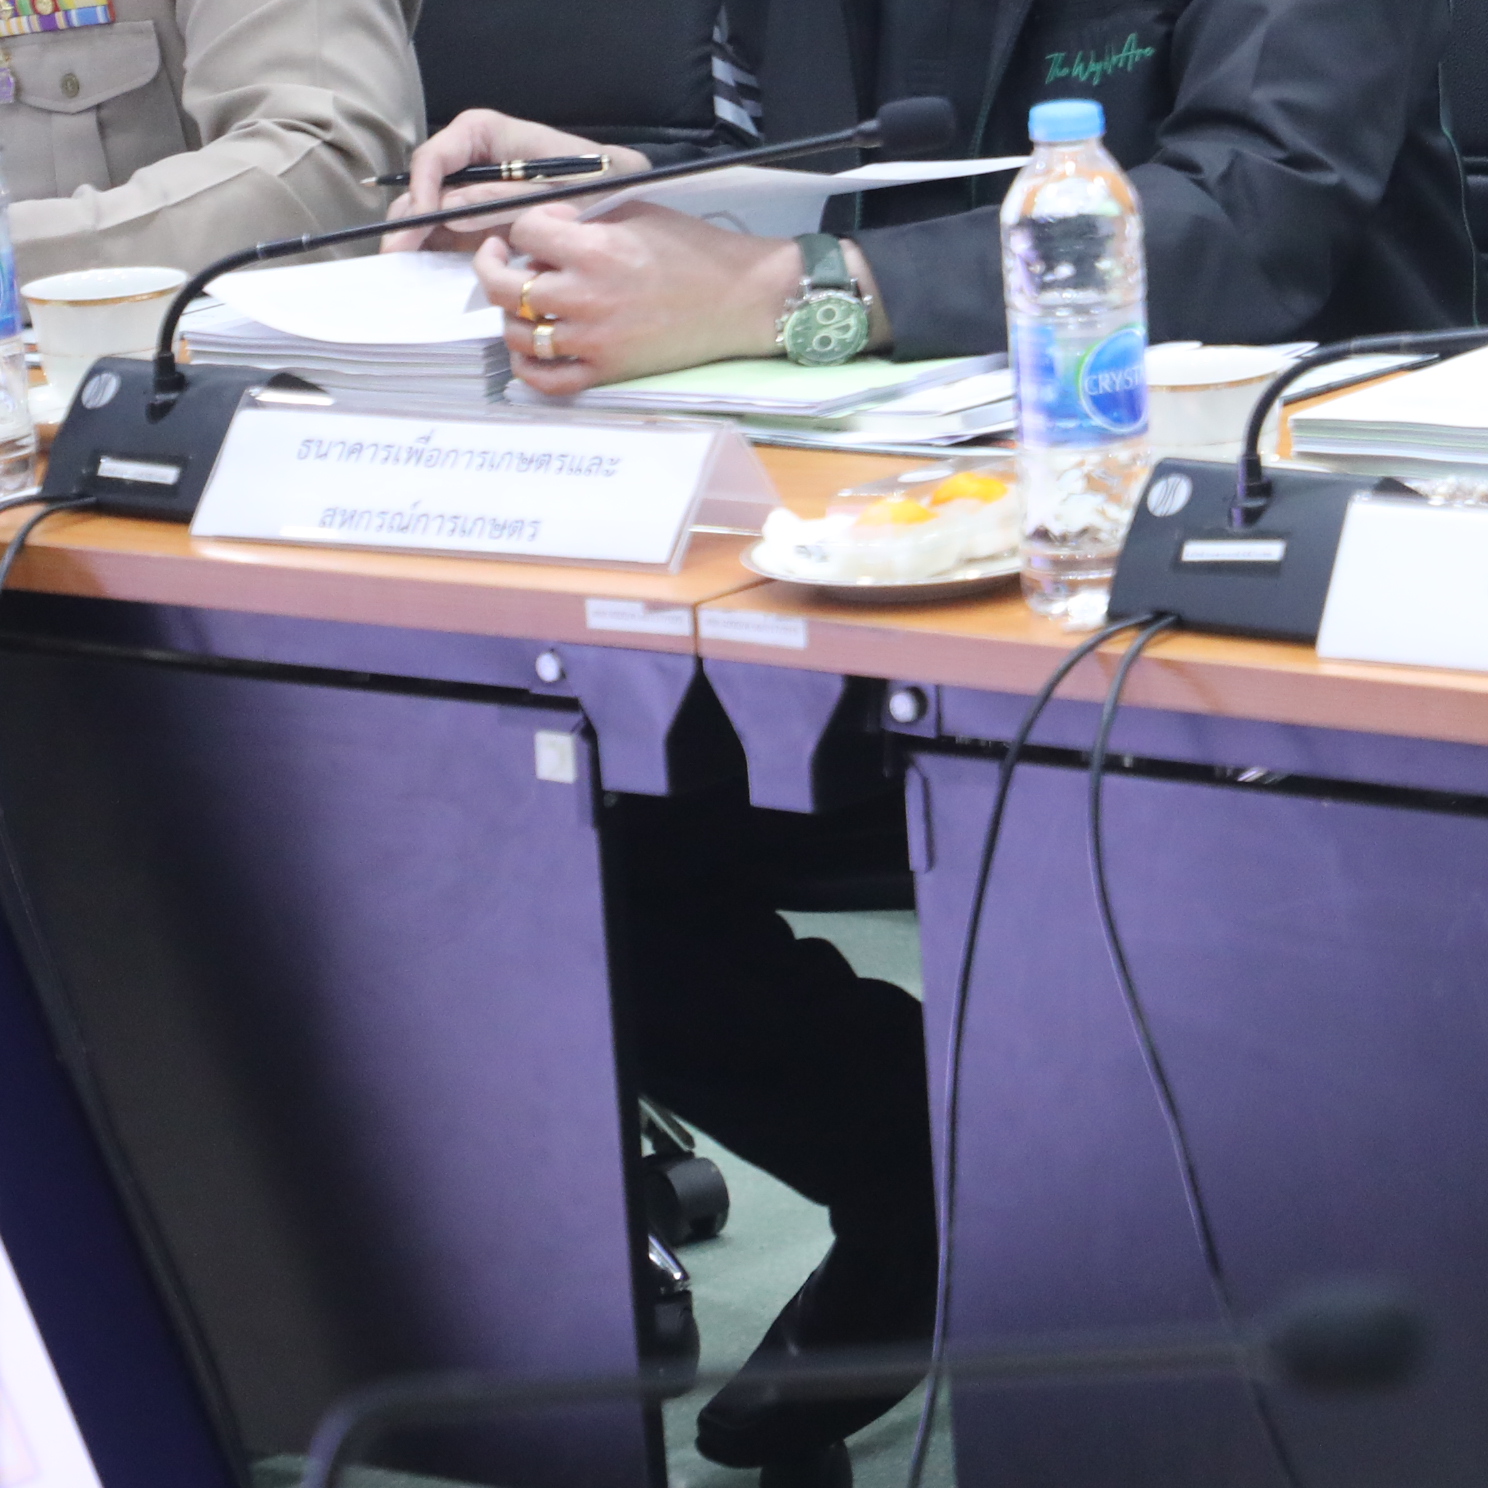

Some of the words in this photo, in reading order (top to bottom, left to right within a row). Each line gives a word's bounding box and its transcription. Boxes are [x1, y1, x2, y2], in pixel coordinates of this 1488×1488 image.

[296, 429, 621, 478] ธนาคารเพื่อการเกษตรและ
[318, 499, 542, 542] สหกรณ์การเกษตร
